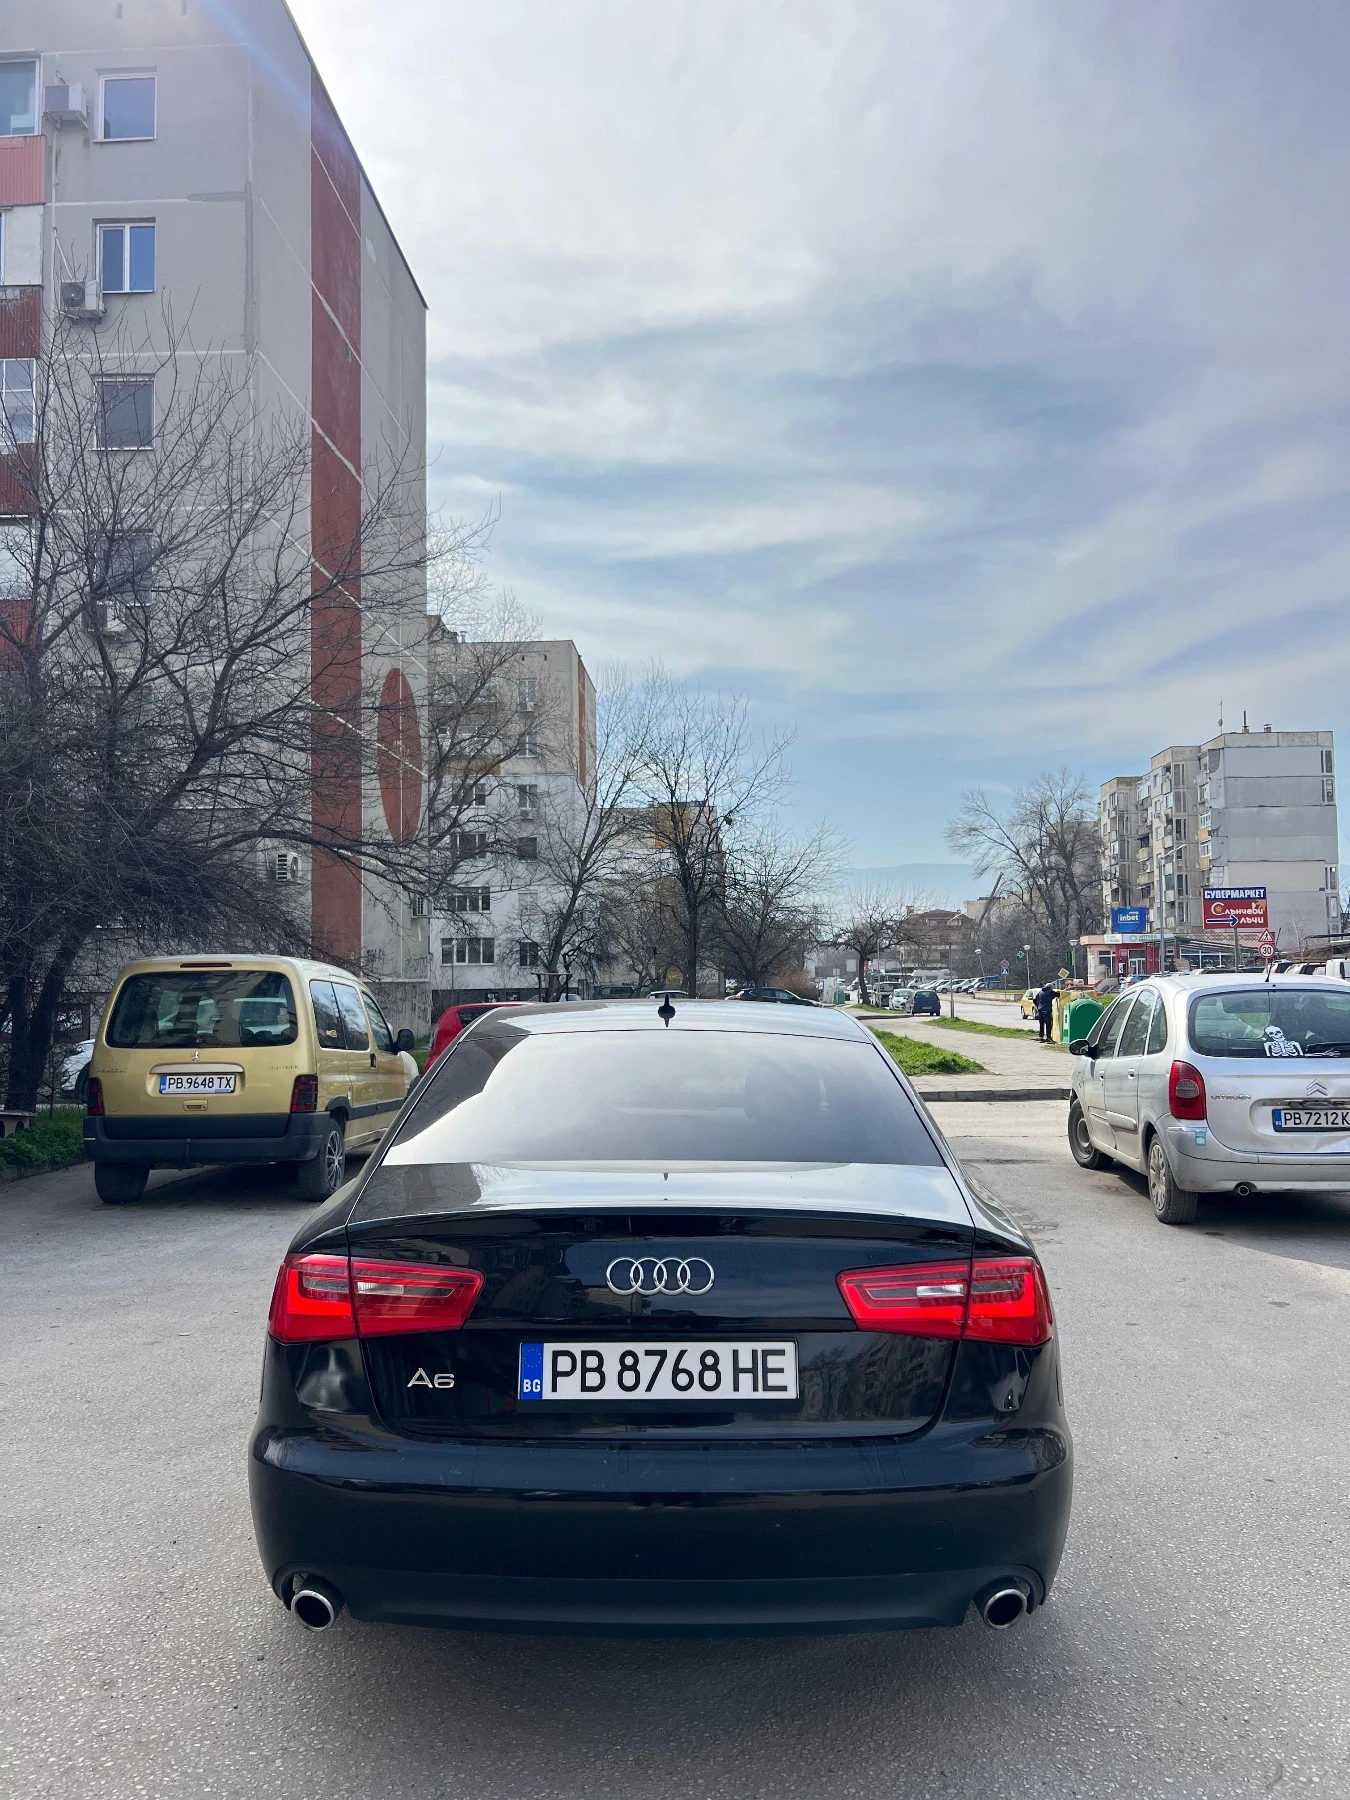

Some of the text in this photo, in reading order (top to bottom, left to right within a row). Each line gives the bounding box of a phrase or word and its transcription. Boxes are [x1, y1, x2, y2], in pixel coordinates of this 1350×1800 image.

[1204, 889, 1264, 899] СУПЕРМАРКЕТ
[1239, 916, 1264, 924] лъчи
[1262, 946, 1272, 955] 30
[217, 1076, 233, 1089] TX
[1341, 1112, 1350, 1126] K
[551, 1349, 788, 1393] PB 8768 HE
[407, 1367, 455, 1389] A6
[523, 1379, 541, 1393] BG
